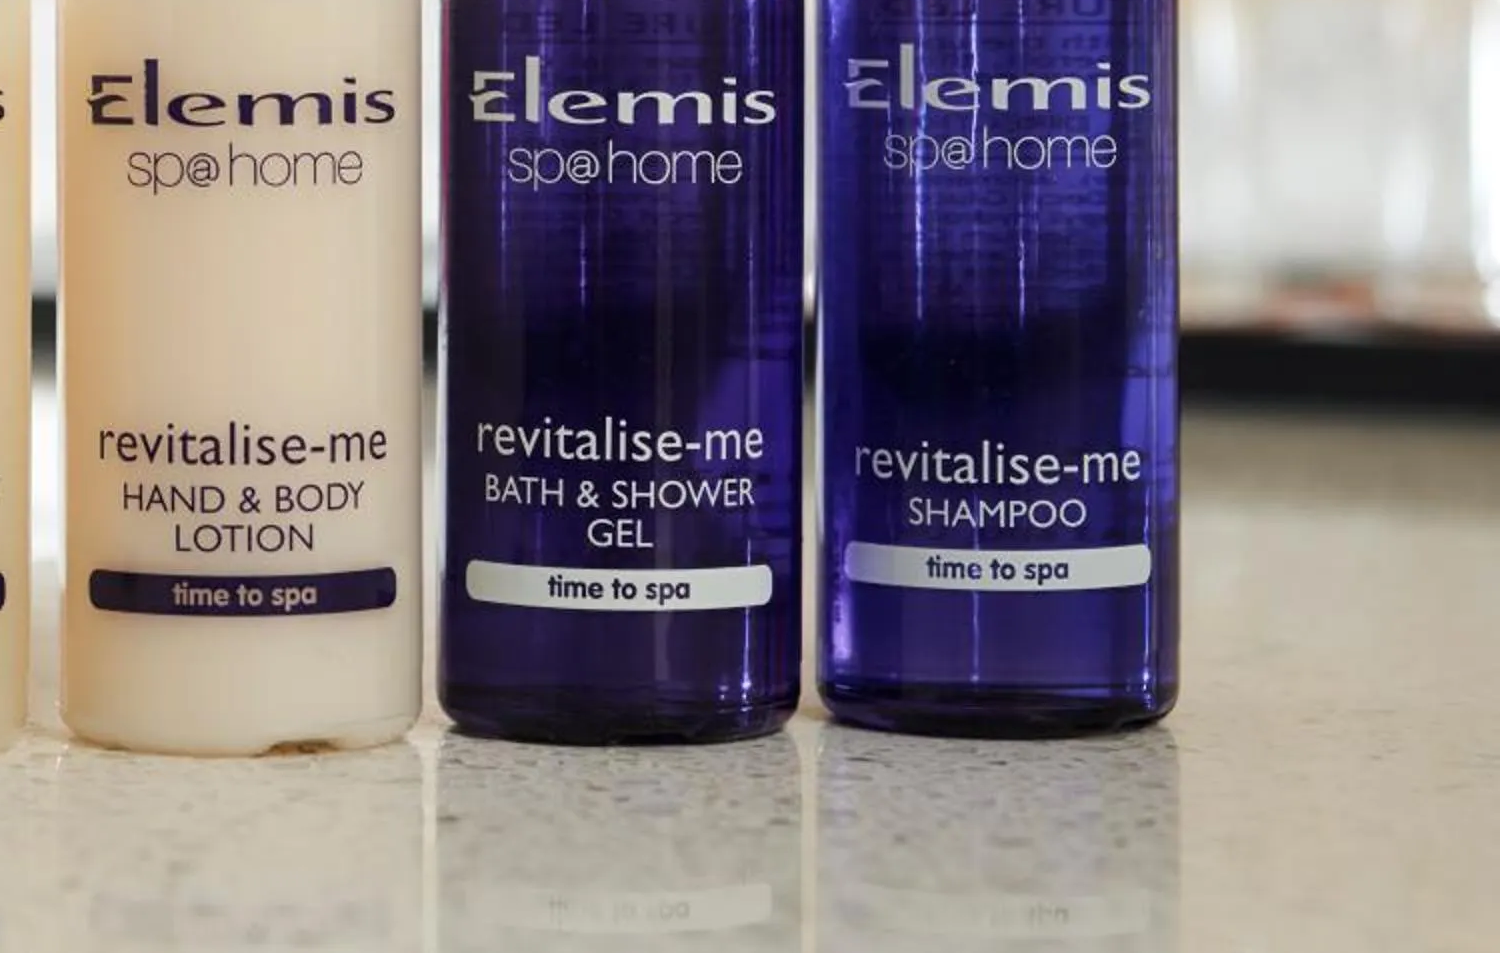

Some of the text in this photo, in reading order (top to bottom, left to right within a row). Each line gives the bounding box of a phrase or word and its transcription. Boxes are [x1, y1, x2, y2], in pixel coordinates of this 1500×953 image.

[86, 58, 395, 128] Elemis
[469, 55, 776, 125] Elemis
[844, 42, 1152, 112] Elemis
[127, 142, 363, 196] sp@home
[506, 139, 744, 192] sp@home
[882, 125, 1118, 177] sp@home
[99, 421, 387, 466] revitalise-me
[478, 416, 764, 462] revitalise-me
[853, 439, 1142, 485] revitalise-me
[123, 480, 365, 514] HAND & BODY
[485, 473, 755, 509] BATH & SHOWER
[909, 497, 1087, 529] SHAMPOO
[175, 523, 313, 553] LOTION
[587, 518, 654, 548] GEL
[547, 574, 691, 606] time to spa
[925, 554, 1071, 587] time to spa
[172, 581, 319, 613] time to spa
